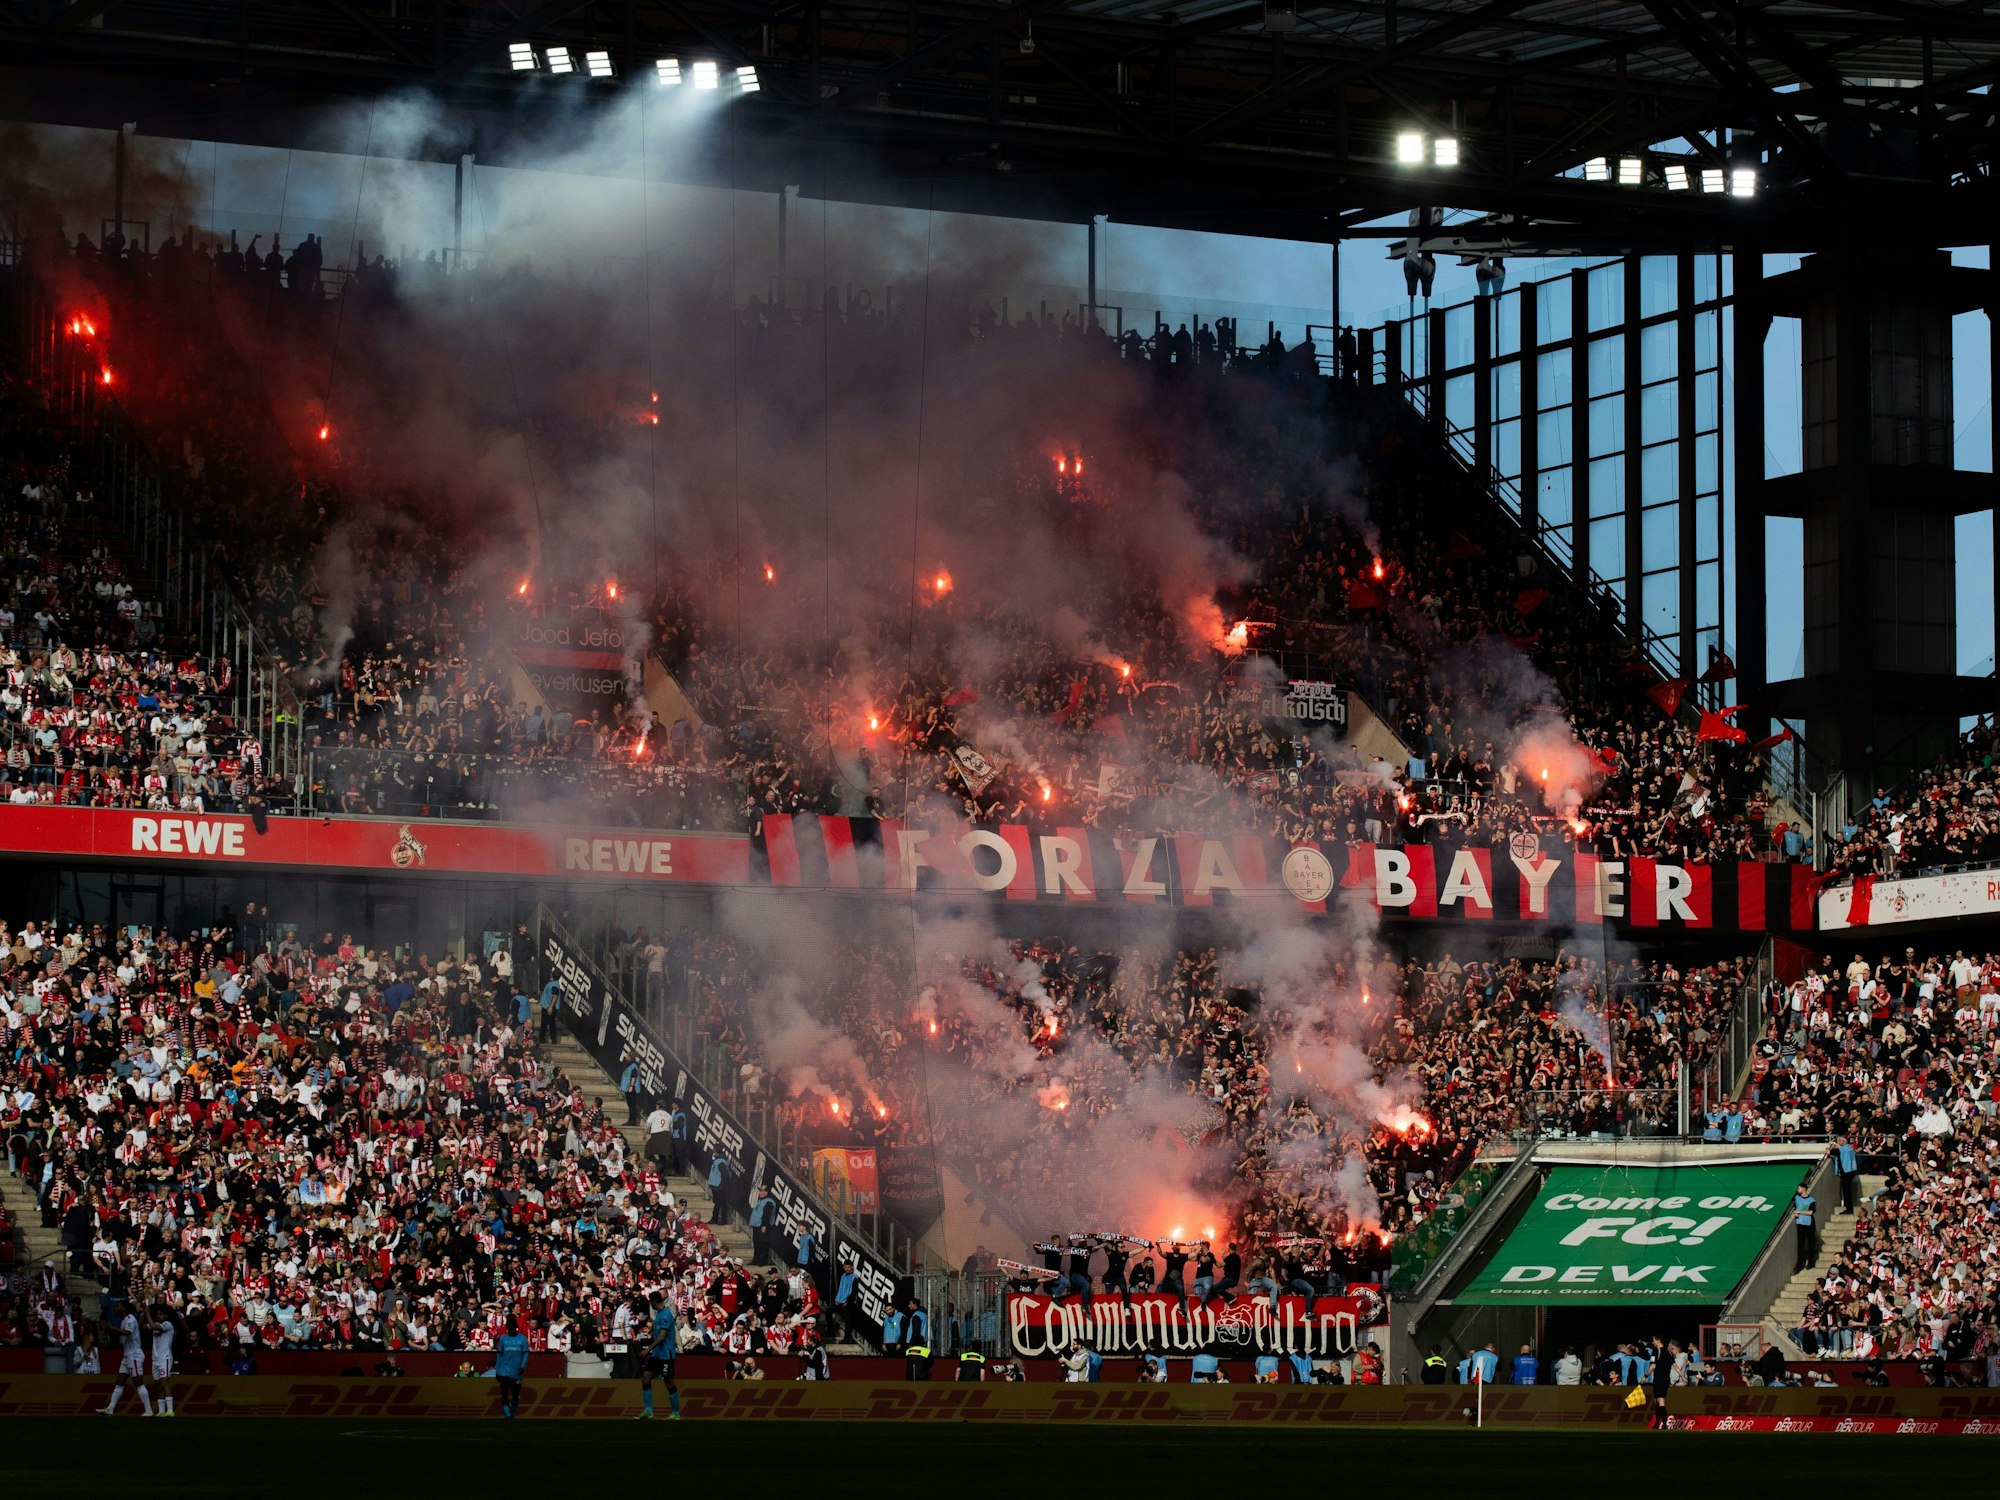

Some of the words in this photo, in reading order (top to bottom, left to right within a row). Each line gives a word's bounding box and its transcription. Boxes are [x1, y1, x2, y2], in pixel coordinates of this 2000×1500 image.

[520, 623, 570, 645] Jood
[530, 673, 625, 696] everkusen
[132, 817, 245, 856] REWE
[565, 838, 673, 874] REWE
[897, 829, 1247, 896] FORZA
[1374, 848, 1699, 920] BAYER
[545, 938, 592, 1000] SILBER
[553, 966, 583, 1018] FEIL
[616, 1013, 665, 1077] SILBER
[619, 1043, 655, 1096] PEIL
[690, 1092, 743, 1159] SILBER
[849, 1155, 876, 1169] 04
[771, 1175, 826, 1244] SILBER
[1544, 1193, 1692, 1211] Come
[1697, 1195, 1775, 1212] on,
[1558, 1215, 1734, 1246] FC!
[1499, 1264, 1717, 1283] DEVK
[284, 1384, 430, 1415] DHL
[486, 1386, 622, 1417] DHL
[681, 1387, 815, 1418] DHL
[867, 1388, 1001, 1419] DHL
[1049, 1389, 1181, 1420] DHL
[1229, 1391, 1355, 1421] DHL
[1400, 1391, 1538, 1421] DHL
[1715, 1416, 1755, 1431] DERTOUR
[1773, 1417, 1814, 1432] DERTOUR
[1835, 1417, 1875, 1433] DERTOUR
[1896, 1417, 1939, 1434] DERTOUR
